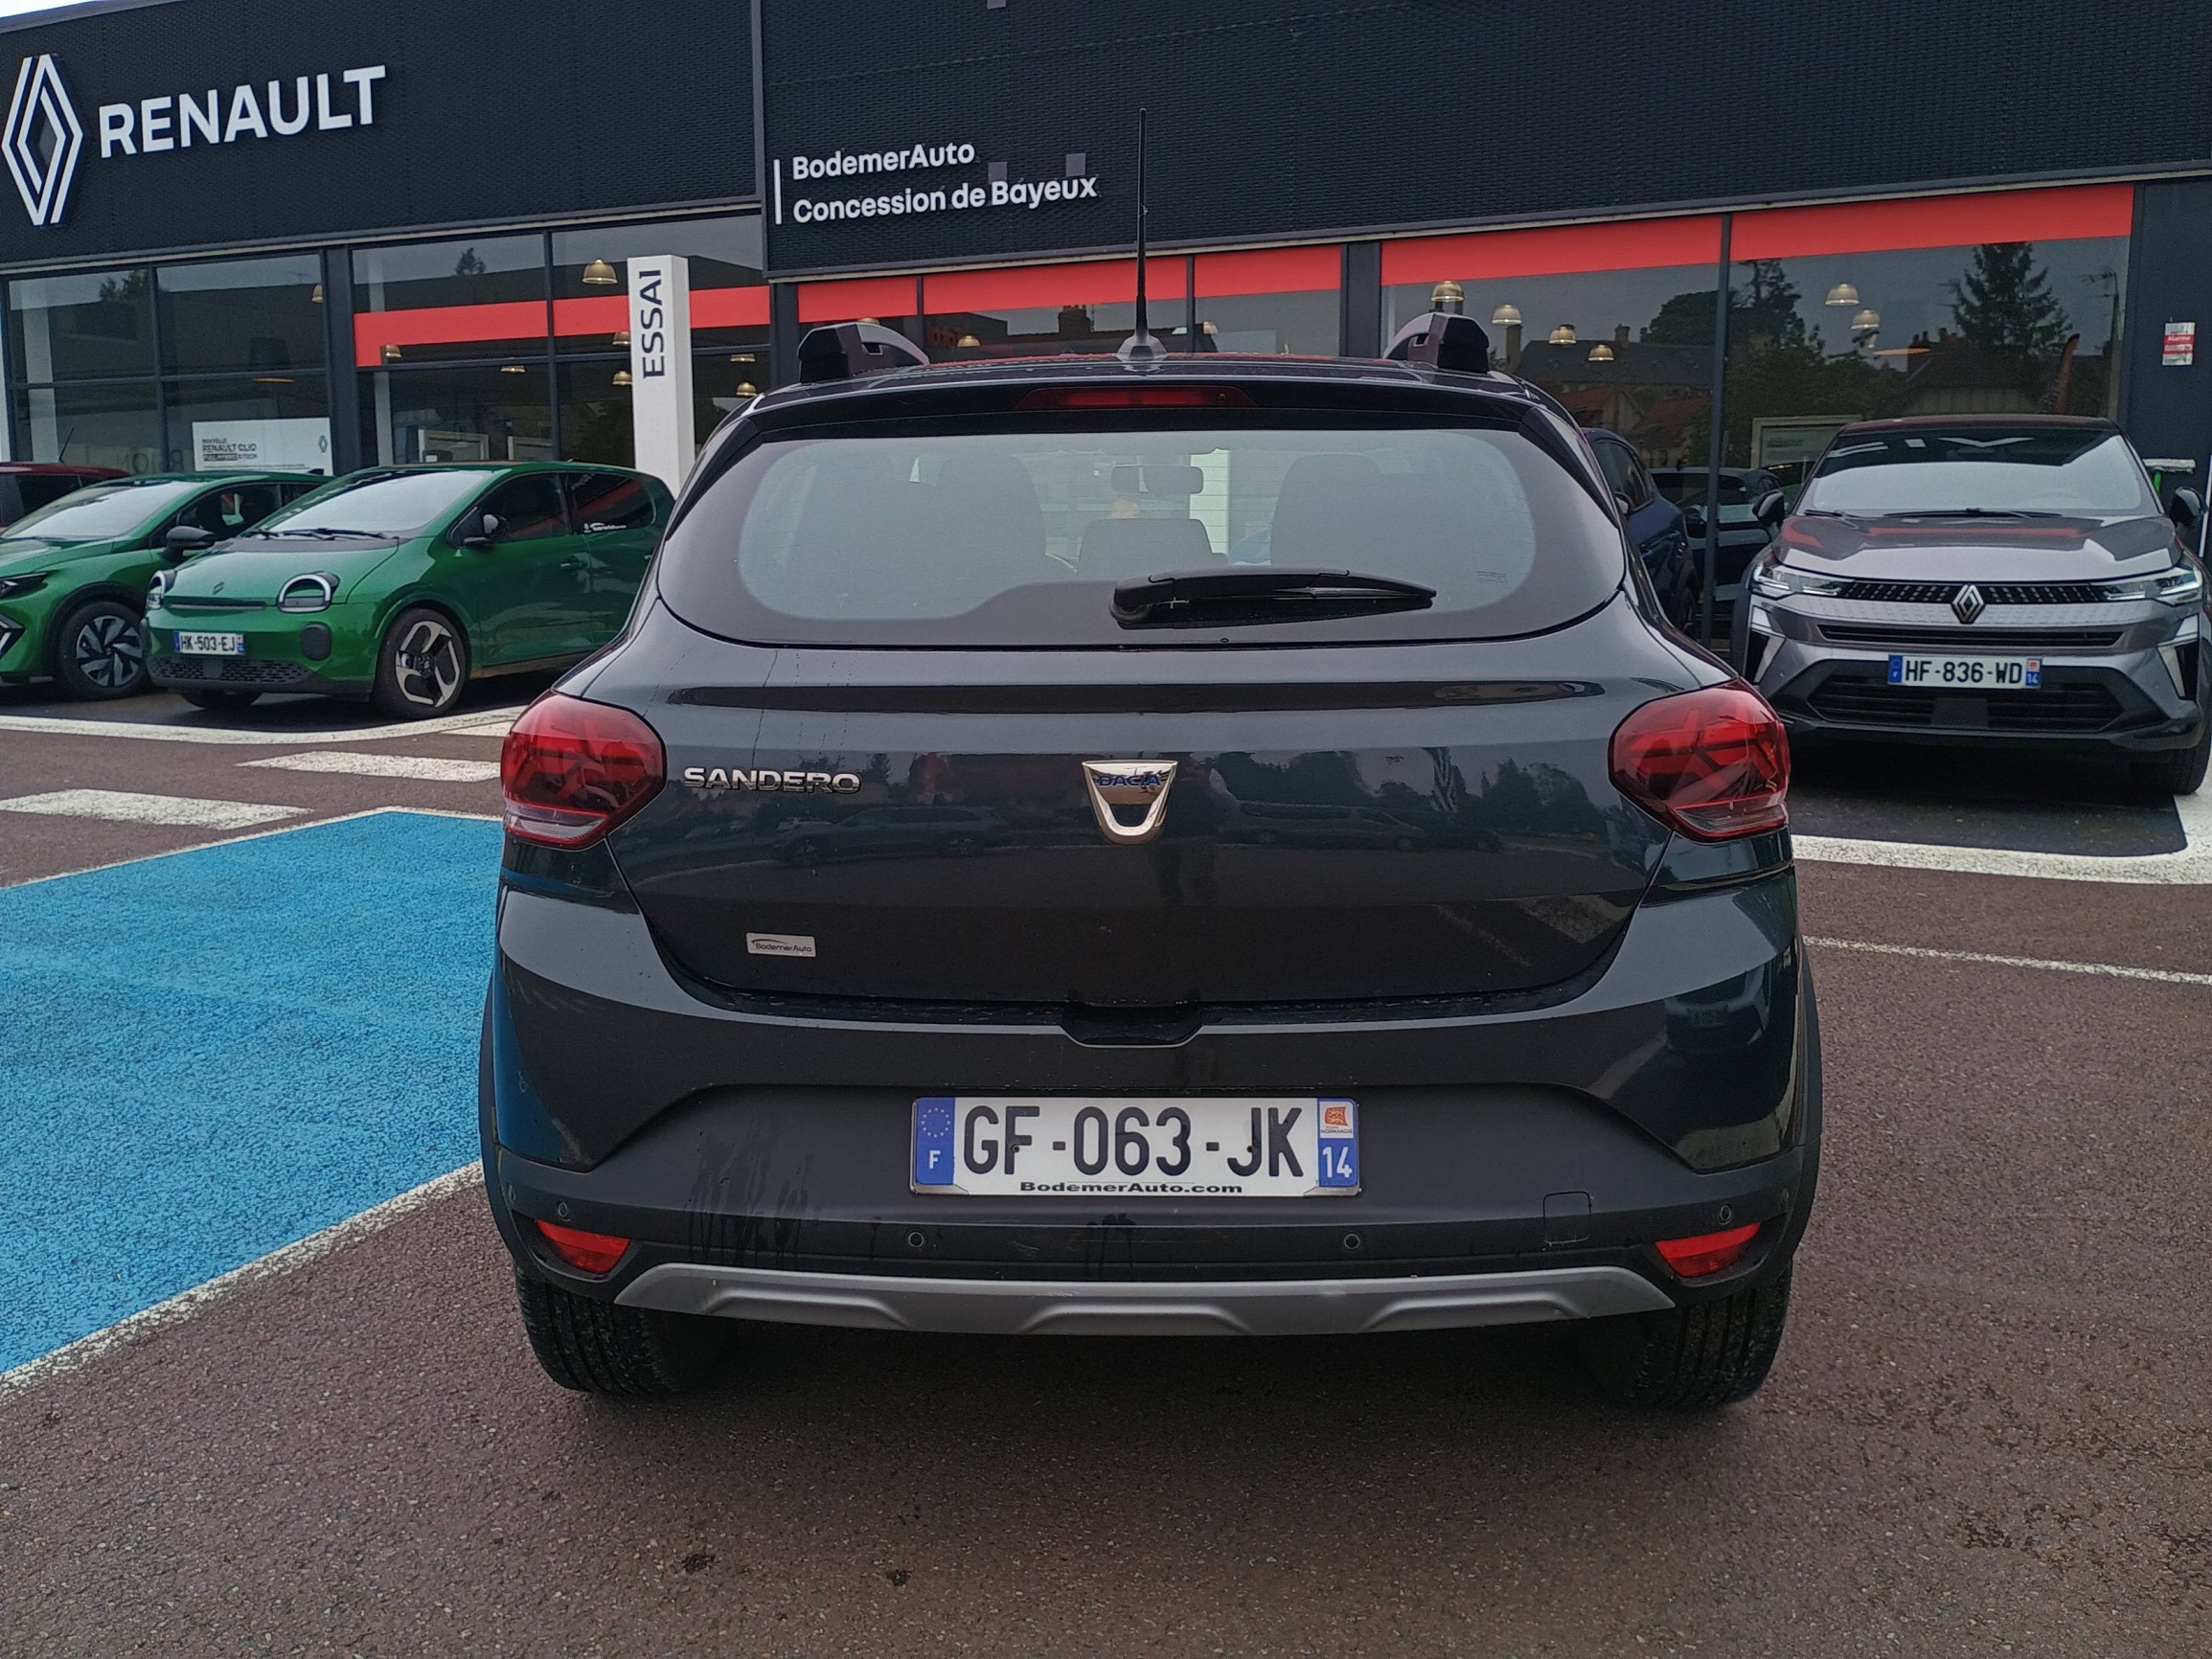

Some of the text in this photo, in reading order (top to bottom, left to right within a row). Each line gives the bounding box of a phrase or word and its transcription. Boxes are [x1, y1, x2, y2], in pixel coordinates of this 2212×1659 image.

[99, 65, 386, 158] RENAULT
[792, 143, 975, 180] BodemerAuto
[793, 175, 1098, 223] Concession de Bayeux
[639, 270, 665, 379] ESSAI
[1905, 661, 2022, 684] HF-836-WD
[684, 767, 860, 793] SANDERO
[1098, 775, 1161, 787] DACIA
[756, 943, 812, 952] BodemerAuto
[964, 1105, 1304, 1177] GF-063-JK
[928, 1150, 941, 1169] F
[1322, 1146, 1353, 1178] 14
[1020, 1181, 1243, 1193] BodemerAuto.com
